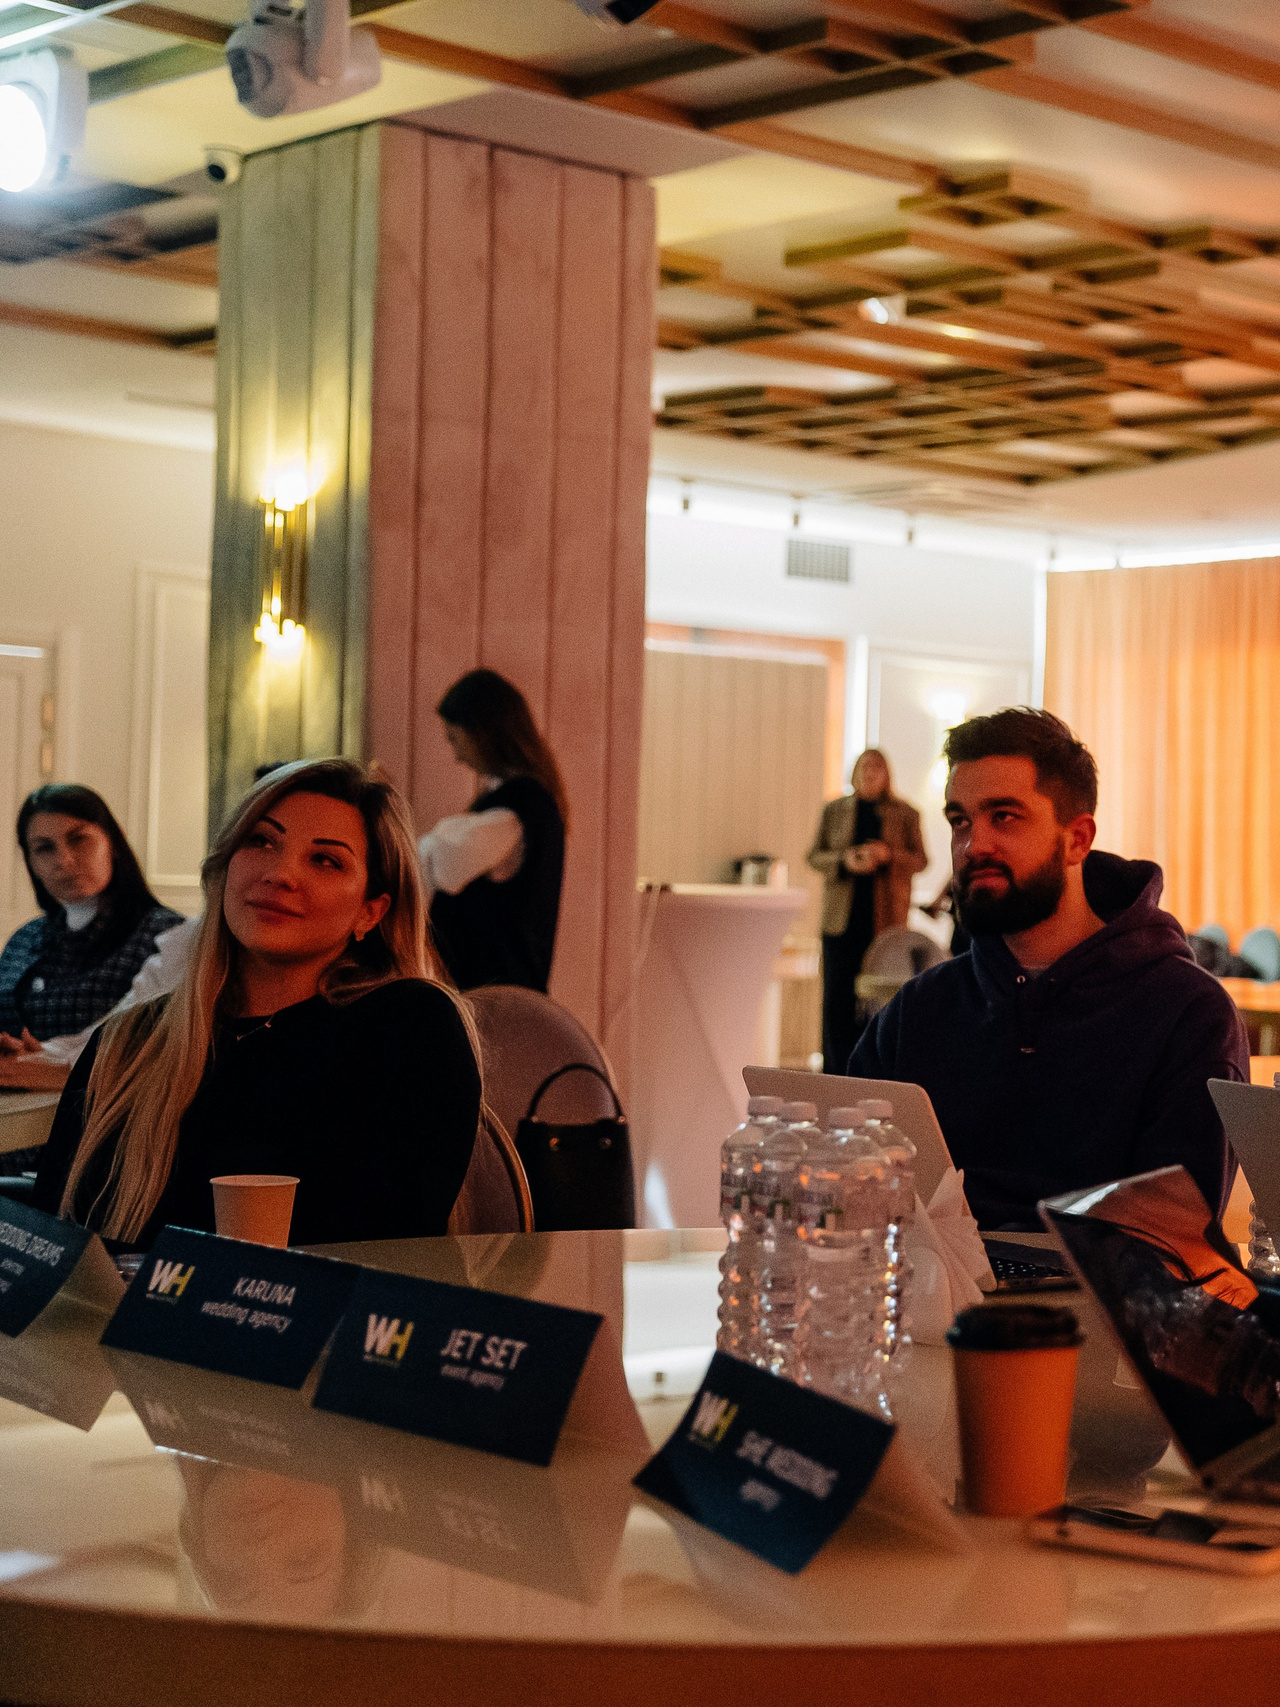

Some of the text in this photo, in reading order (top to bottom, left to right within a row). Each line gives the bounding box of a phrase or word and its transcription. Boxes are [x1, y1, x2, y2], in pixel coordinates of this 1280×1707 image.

[233, 1277, 297, 1306] KARUNA
[201, 1300, 292, 1334] wedding agency
[440, 1329, 528, 1370] JET SET
